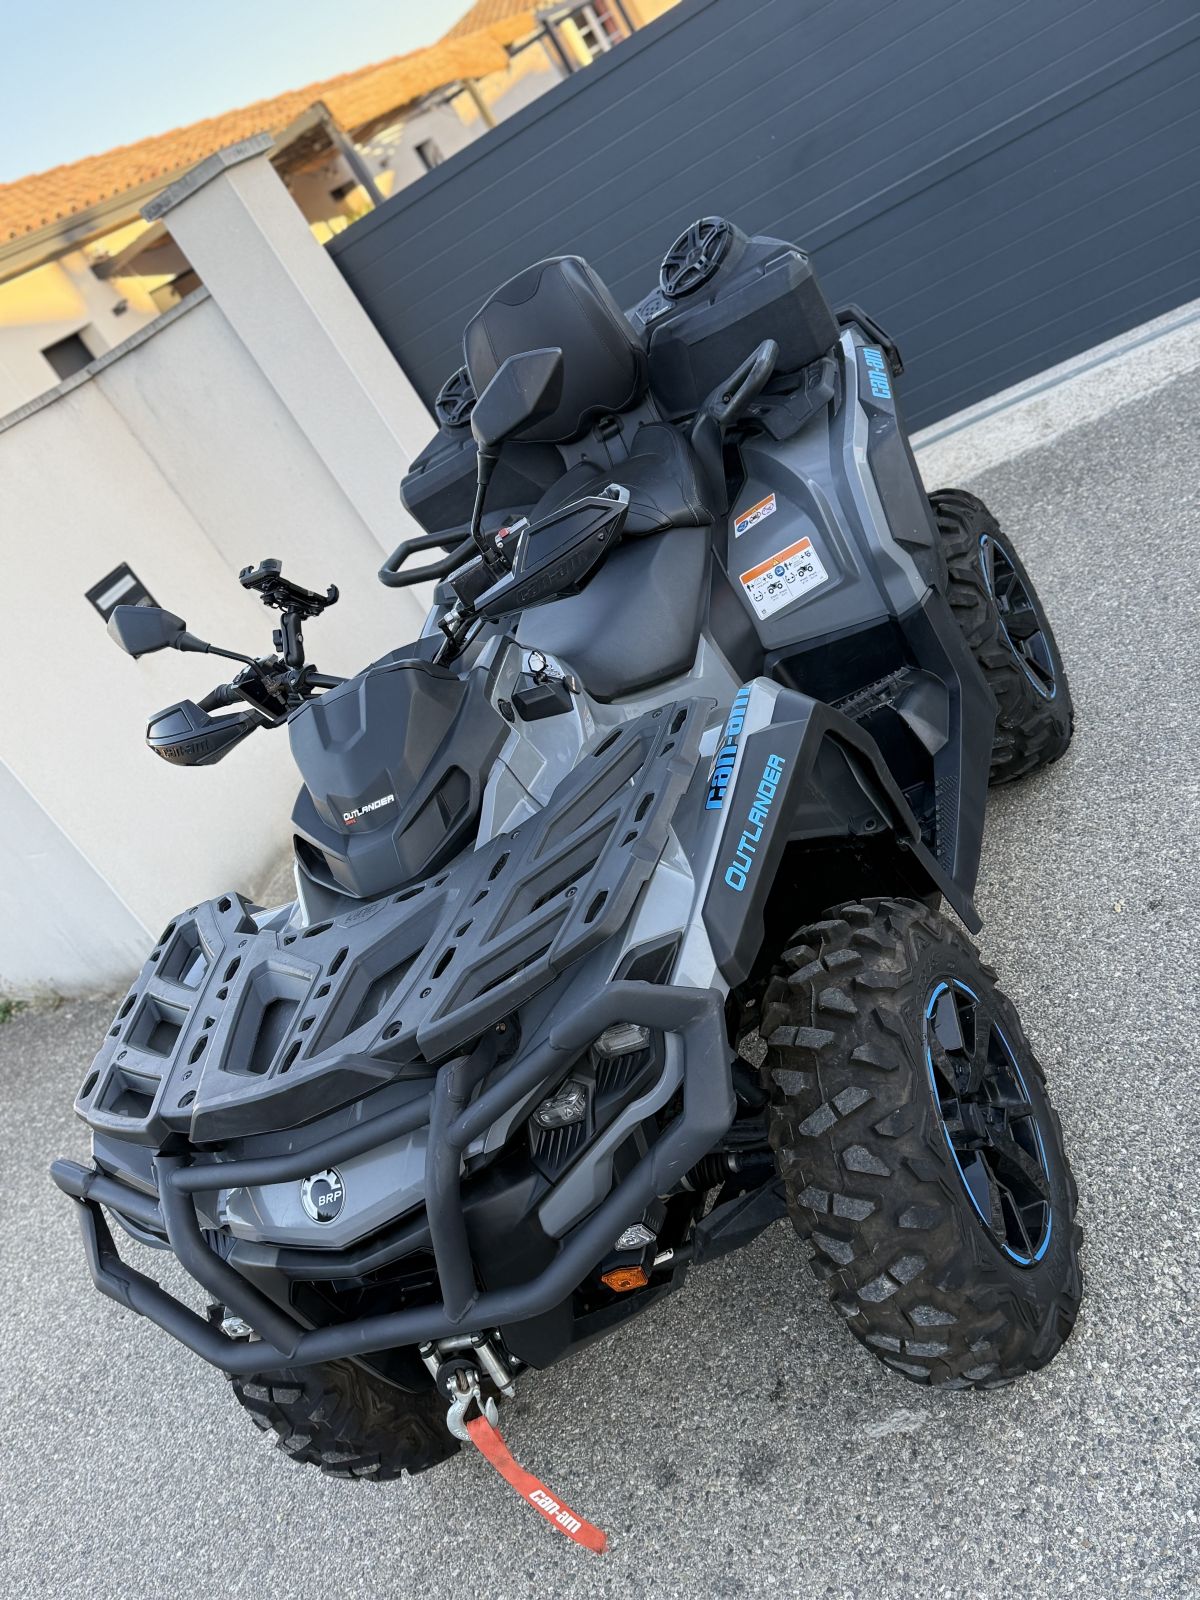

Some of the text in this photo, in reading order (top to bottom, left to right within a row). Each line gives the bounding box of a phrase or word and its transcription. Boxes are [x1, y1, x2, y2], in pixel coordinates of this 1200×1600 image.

[863, 347, 892, 399] can-am
[705, 687, 750, 811] can-am
[343, 793, 395, 822] OUTLANDER
[725, 754, 786, 892] OUTLANDER
[318, 1190, 342, 1207] BRP
[528, 1489, 582, 1534] can-am
